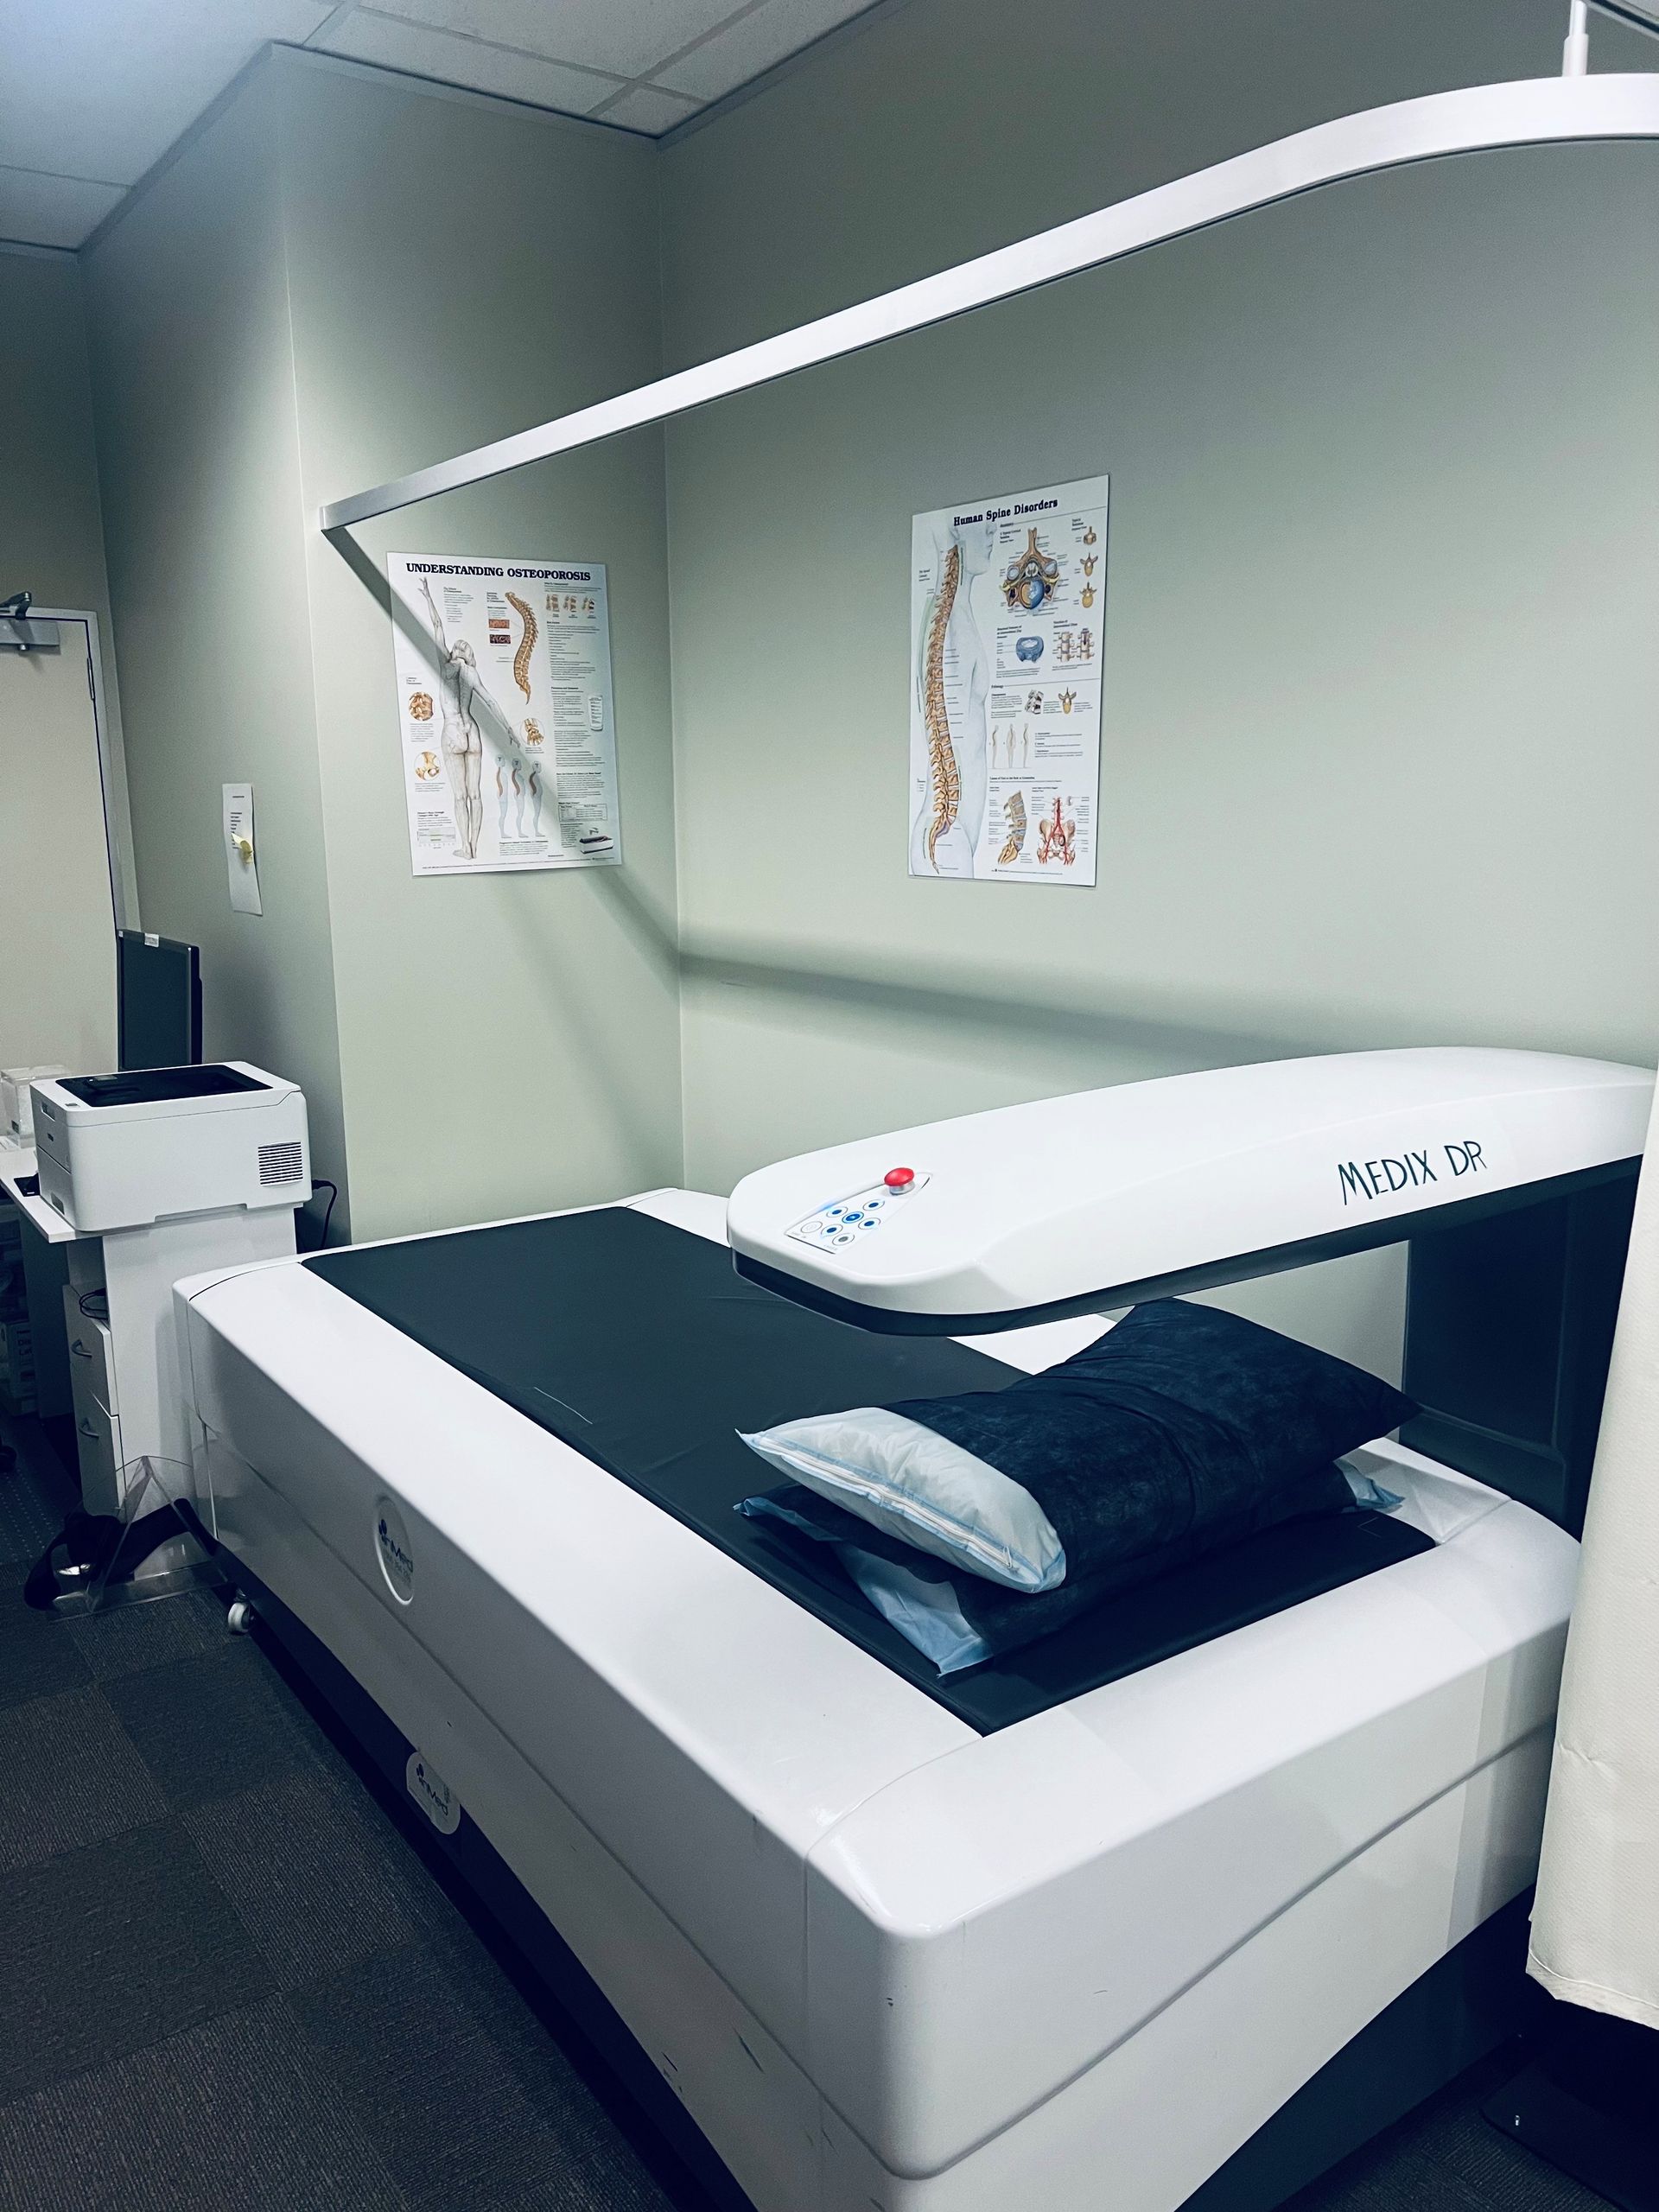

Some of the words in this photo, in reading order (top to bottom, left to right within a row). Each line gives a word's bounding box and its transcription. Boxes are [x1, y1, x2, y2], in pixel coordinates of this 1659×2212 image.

[953, 514, 983, 526] Human
[986, 508, 1011, 522] Spine
[1014, 499, 1058, 515] Disorders
[406, 563, 504, 576] UNDERSTANDING
[506, 568, 591, 581] OSTEOPOROSIS
[1338, 1149, 1438, 1205] MEDIX
[1444, 1141, 1488, 1176] DR
